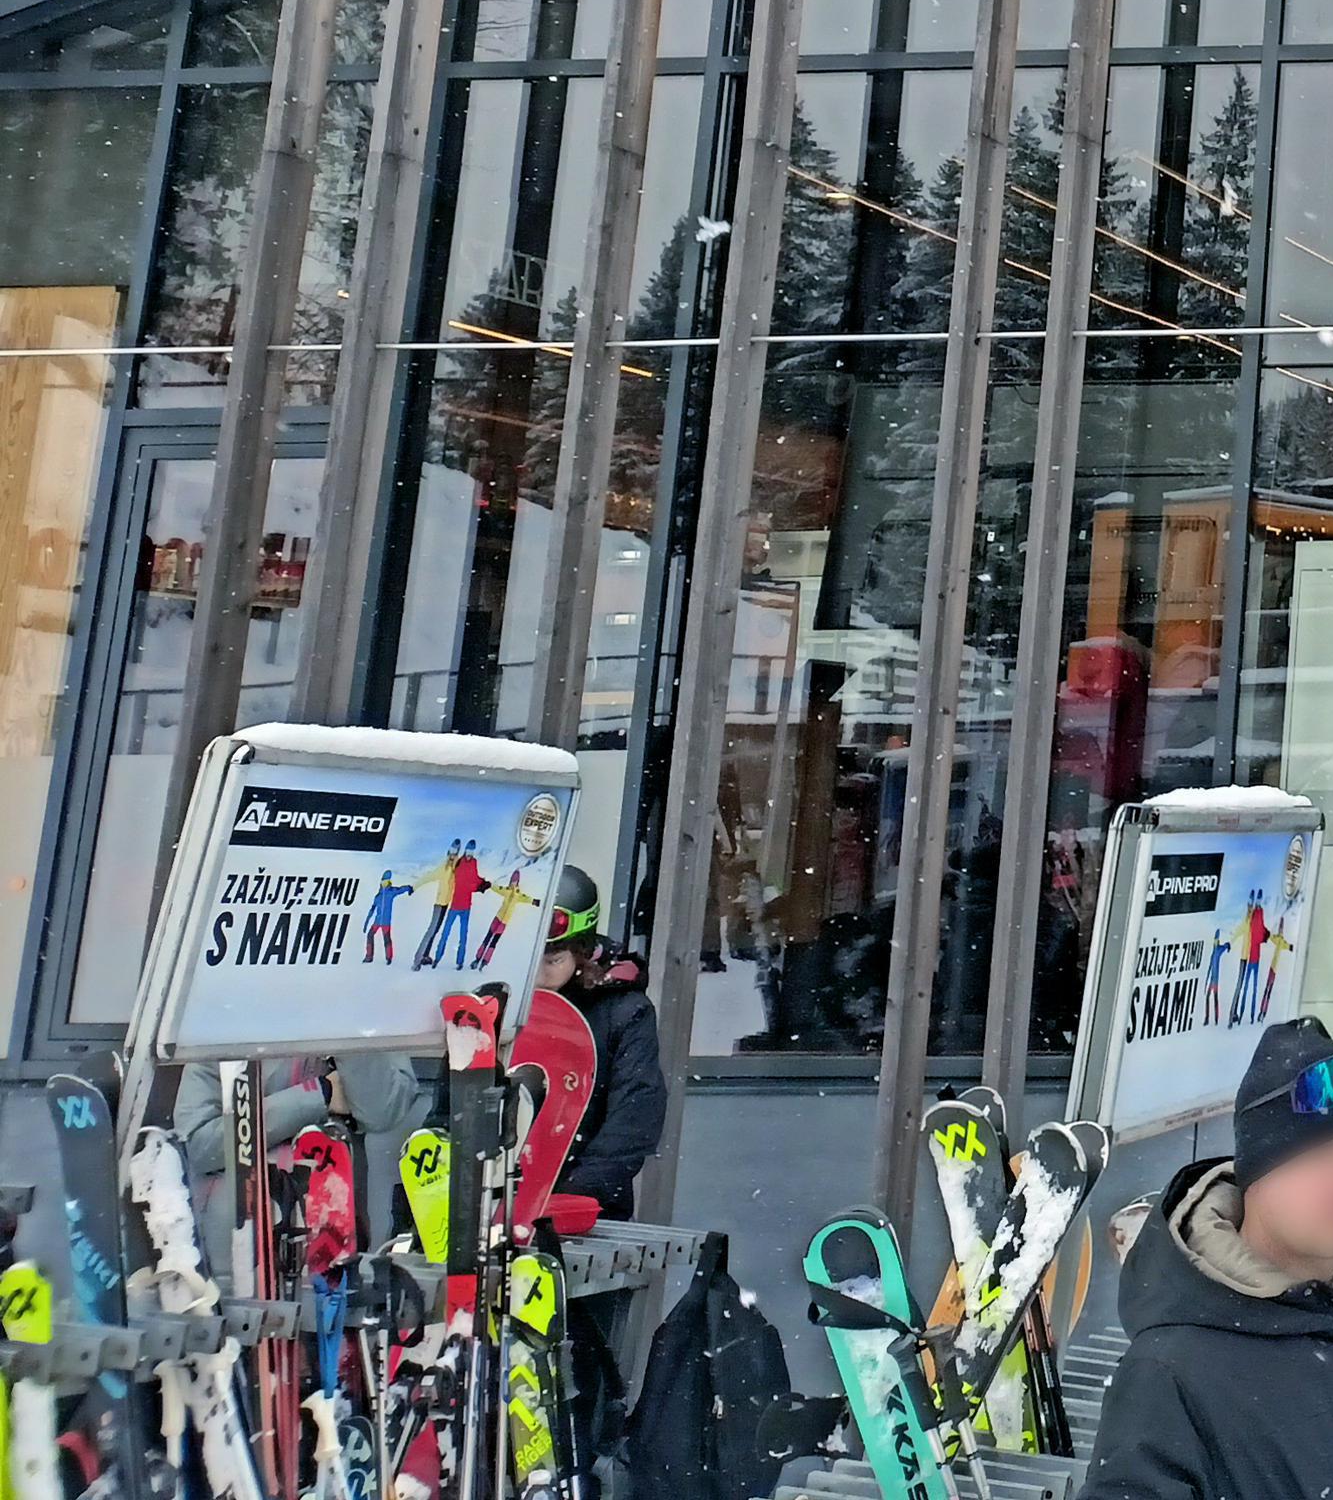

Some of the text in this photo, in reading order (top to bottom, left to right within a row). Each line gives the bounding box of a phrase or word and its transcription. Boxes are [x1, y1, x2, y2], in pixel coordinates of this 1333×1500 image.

[233, 801, 386, 833] ALPINE PRO
[220, 867, 360, 907] ZAŽIJTE ZIMU
[1146, 870, 1219, 902] ALPINE PRO
[206, 899, 351, 967] S NÁMI!
[1135, 938, 1205, 979] ZAŽIJTE ZIMU
[1126, 967, 1199, 1044] S NÁMI!
[515, 1427, 547, 1464] RACE
[517, 1436, 552, 1472] TIGER
